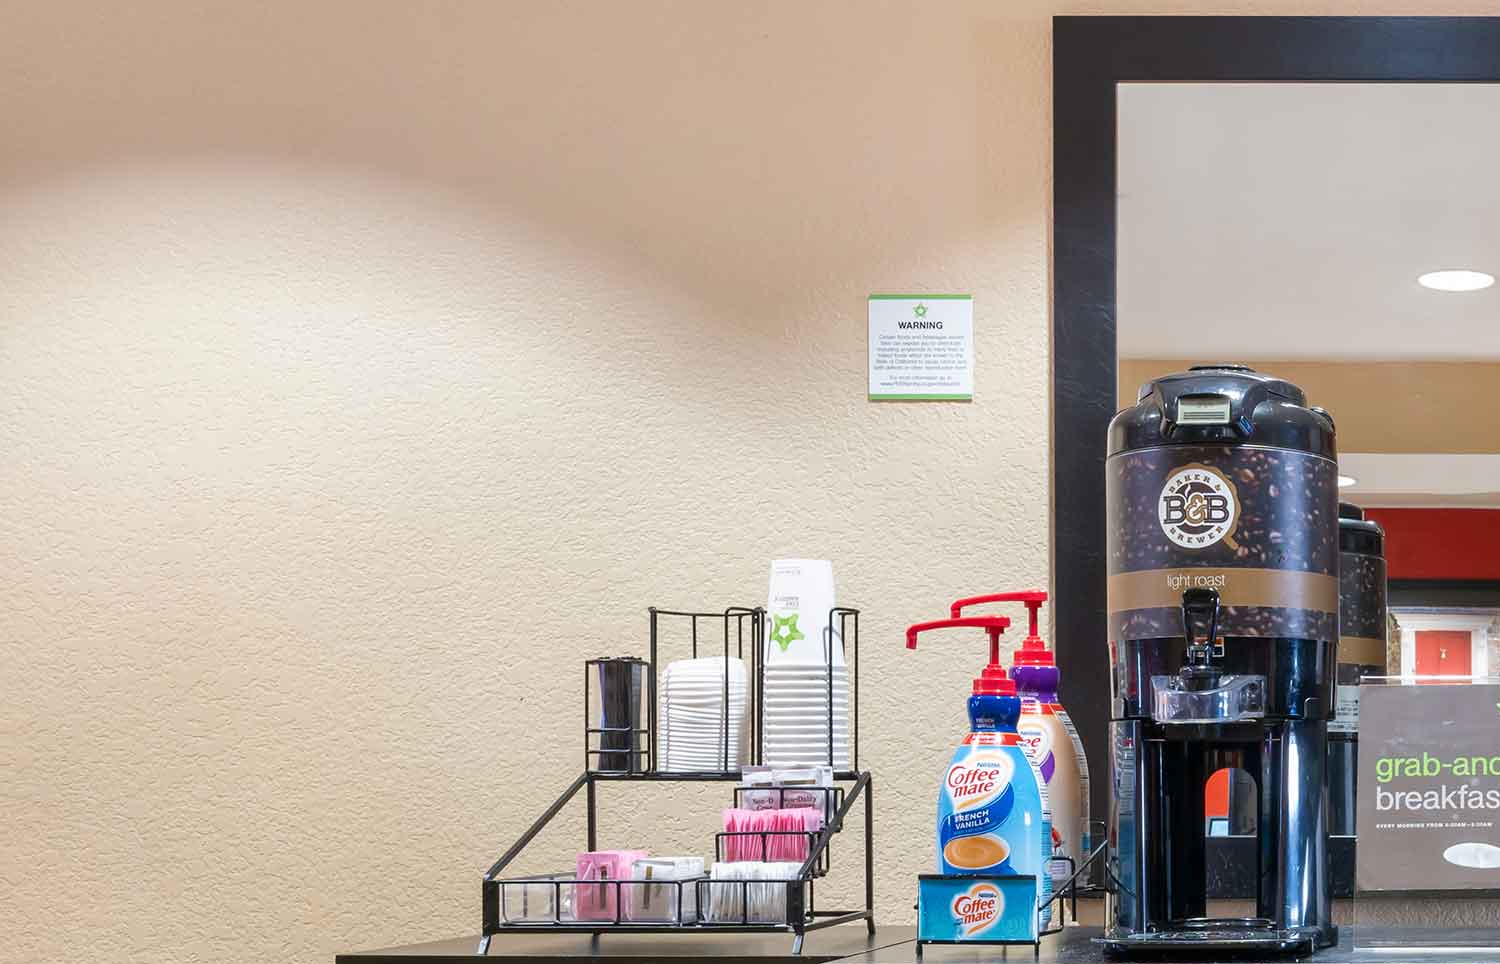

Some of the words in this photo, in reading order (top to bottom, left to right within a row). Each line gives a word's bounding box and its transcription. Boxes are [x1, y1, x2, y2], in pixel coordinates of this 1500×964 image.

[898, 321, 943, 329] WARNING
[1163, 493, 1230, 525] B&B
[1167, 574, 1190, 590] light
[1194, 574, 1225, 586] roast
[948, 765, 1000, 788] Coffee
[954, 781, 994, 798] mate
[955, 810, 989, 823] FRENCH
[955, 817, 990, 830] VANILLA
[954, 895, 995, 916] Coffee
[964, 911, 993, 924] mate
